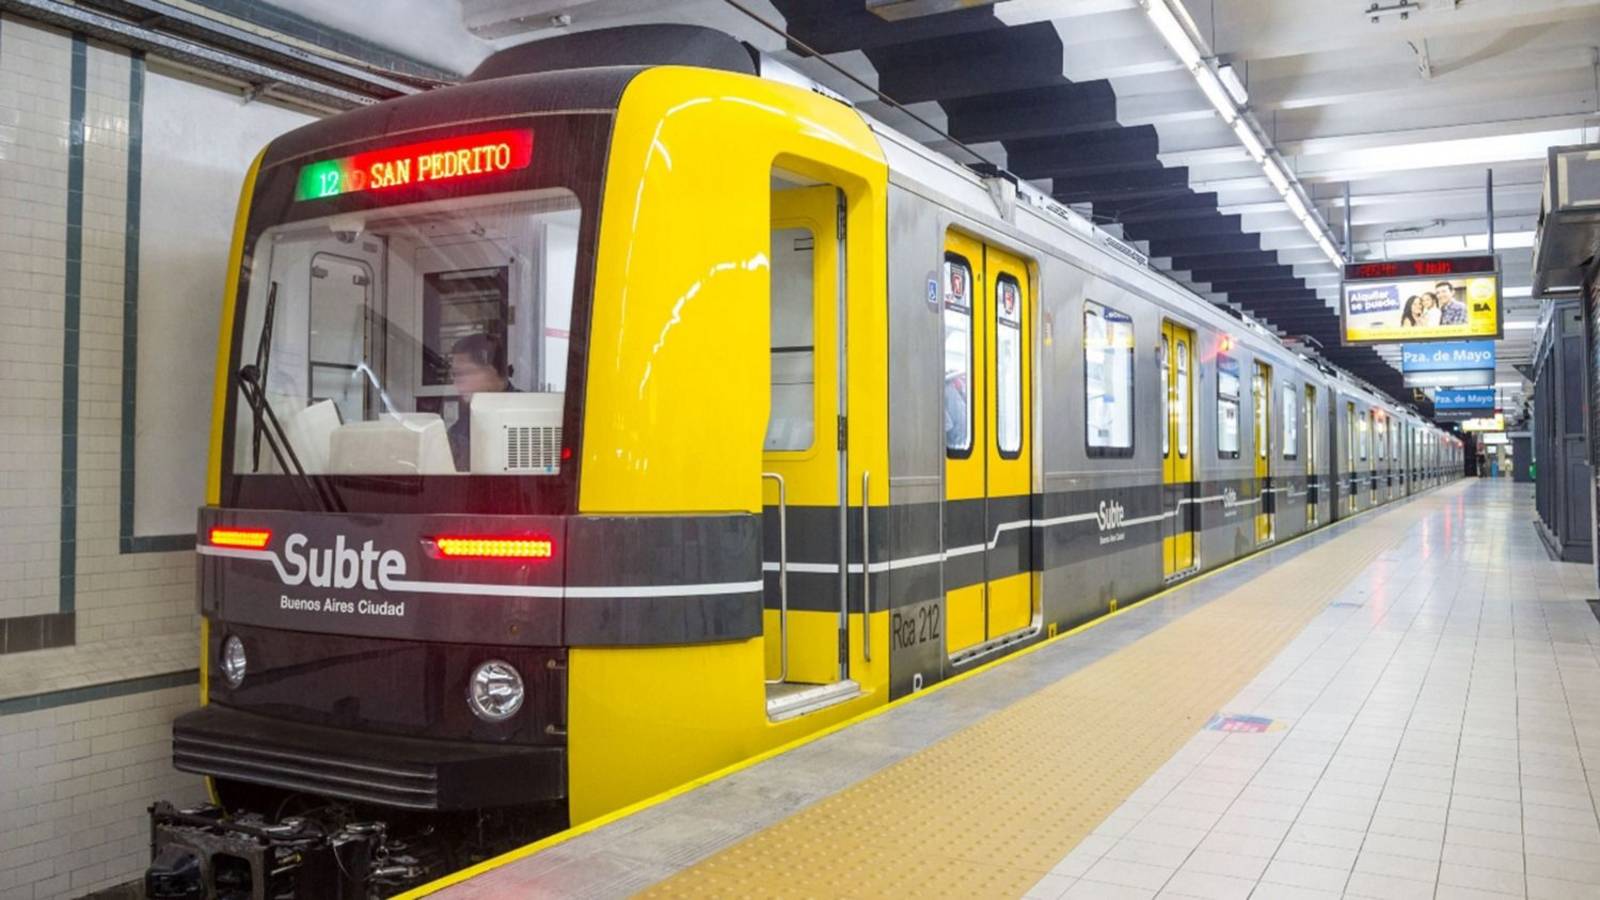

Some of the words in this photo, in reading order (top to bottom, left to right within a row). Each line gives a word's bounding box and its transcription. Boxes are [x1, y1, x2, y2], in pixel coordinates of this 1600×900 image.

[320, 170, 339, 197] 12
[370, 158, 410, 189] SAN
[417, 144, 511, 182] PEDRITO
[1473, 302, 1491, 312] BA
[1403, 351, 1430, 363] Pza.
[1433, 350, 1450, 361] de
[1453, 349, 1492, 362] Mayo
[1454, 394, 1466, 403] de
[1467, 394, 1493, 405] Mayo
[1099, 500, 1124, 531] Subte
[282, 532, 407, 592] Subte
[280, 595, 321, 611] Buenos
[323, 598, 354, 613] Aires
[357, 600, 405, 616] Ciudad
[892, 613, 916, 651] Rca
[919, 603, 940, 643] 212
